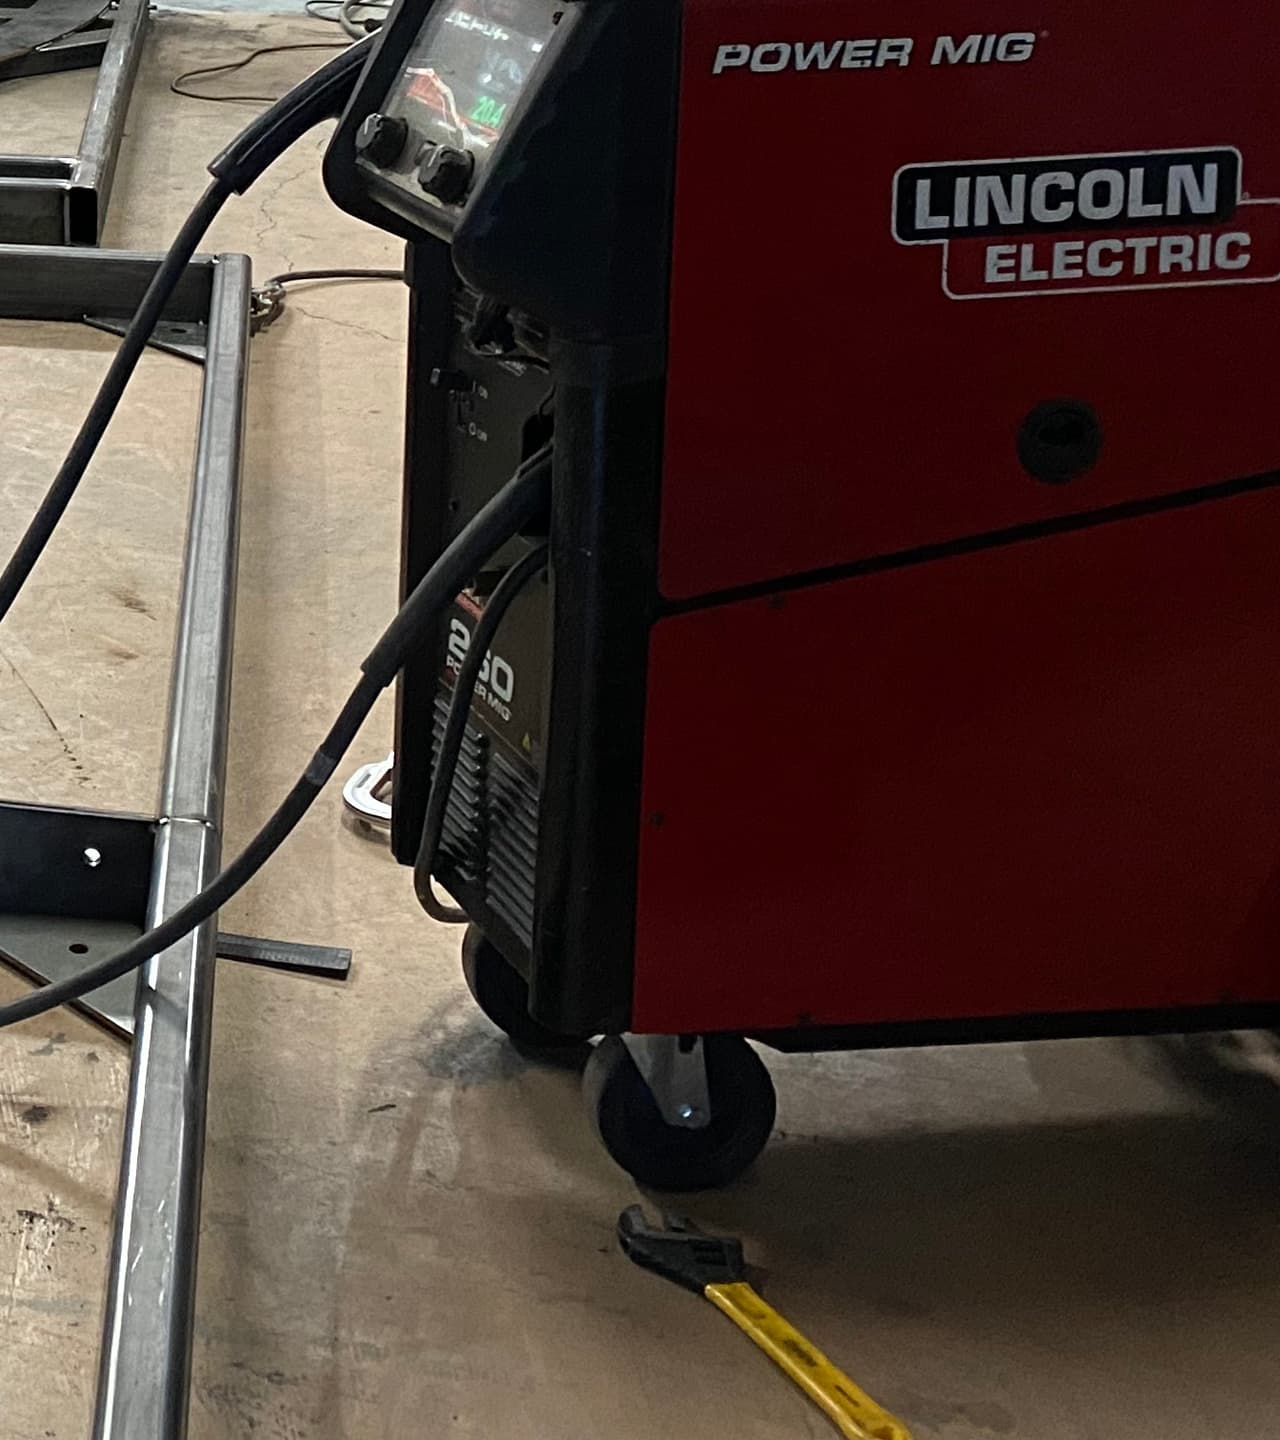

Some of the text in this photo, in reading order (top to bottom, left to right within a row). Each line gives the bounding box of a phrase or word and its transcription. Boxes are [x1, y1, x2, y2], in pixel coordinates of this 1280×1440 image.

[712, 32, 1036, 74] POWER MIG
[913, 163, 1219, 230] LINCOLN
[984, 232, 1251, 284] ELECTRIC
[445, 654, 513, 722] POER MIG
